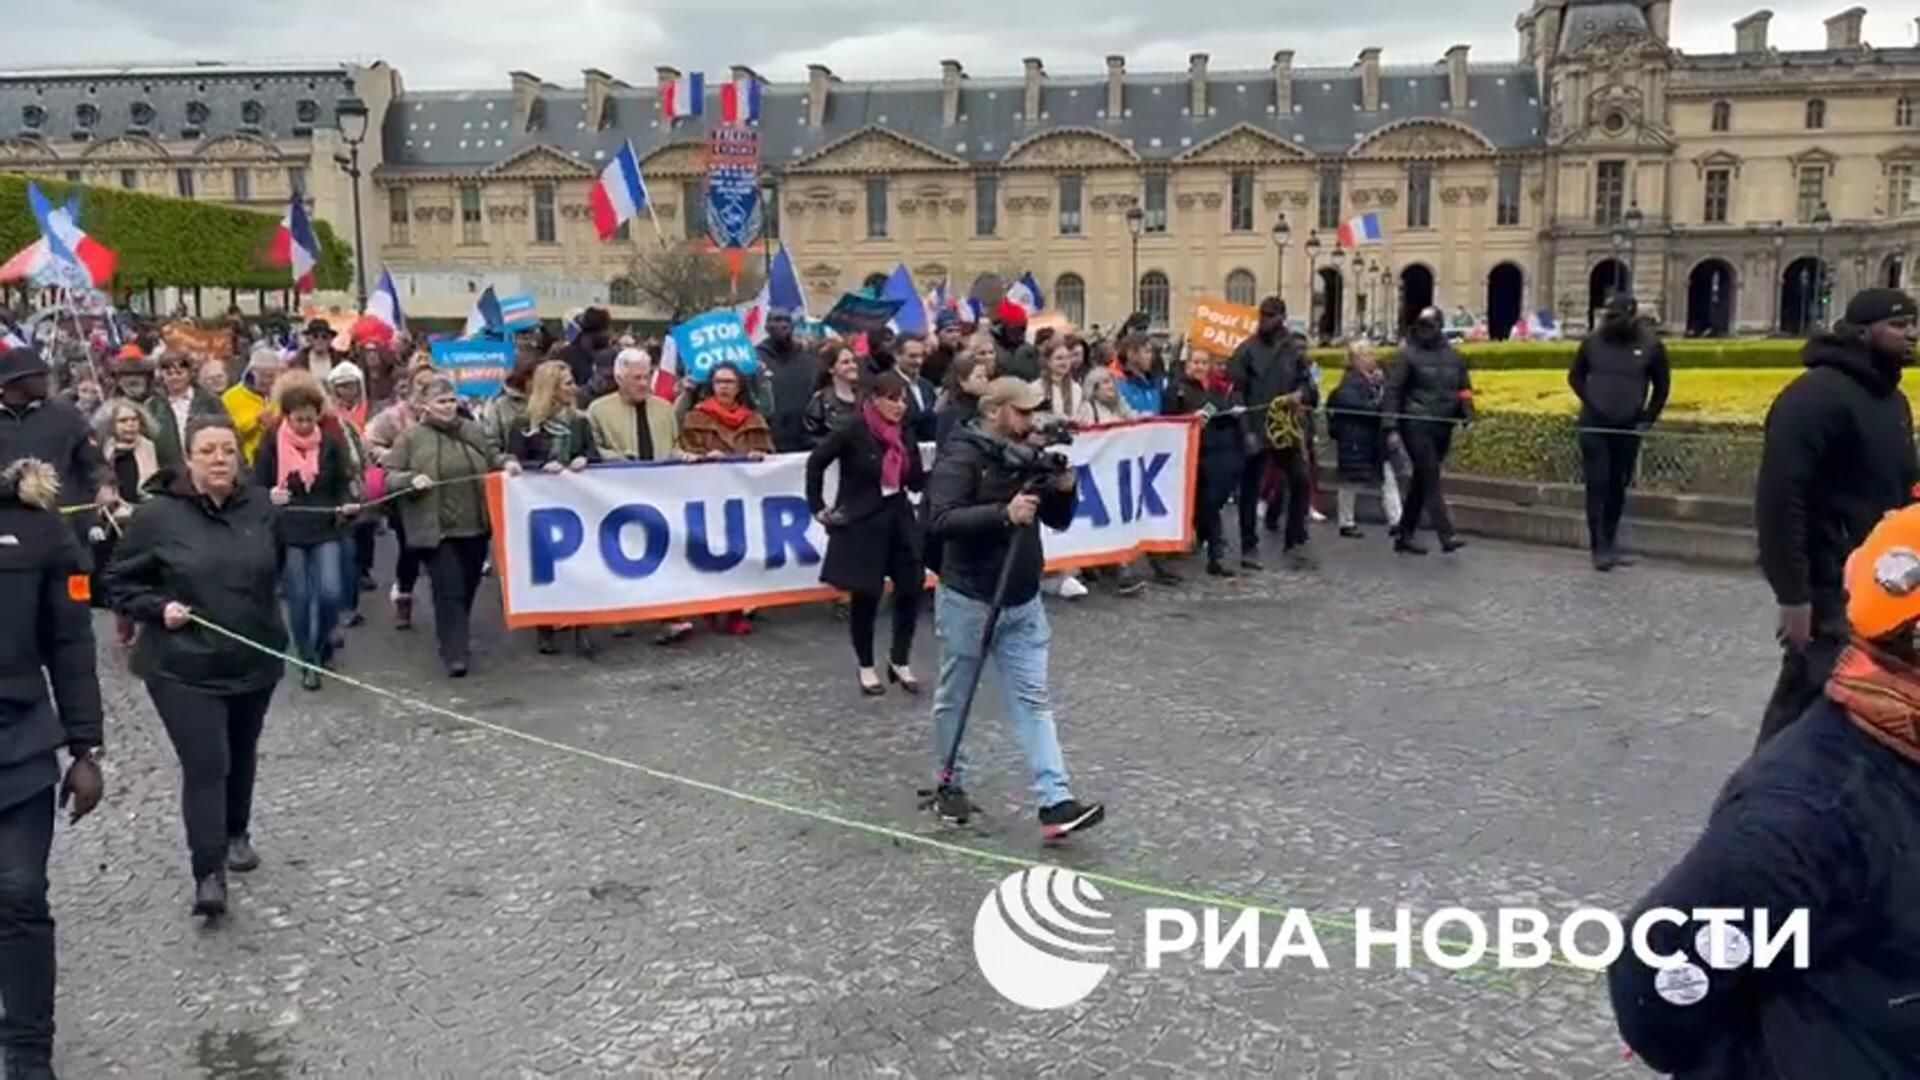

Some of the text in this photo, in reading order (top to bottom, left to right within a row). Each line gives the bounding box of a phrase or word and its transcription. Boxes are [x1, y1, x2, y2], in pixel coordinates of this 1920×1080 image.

[689, 322, 740, 348] STOP
[695, 344, 751, 369] OTAN
[529, 452, 1172, 585] POUR AIX
